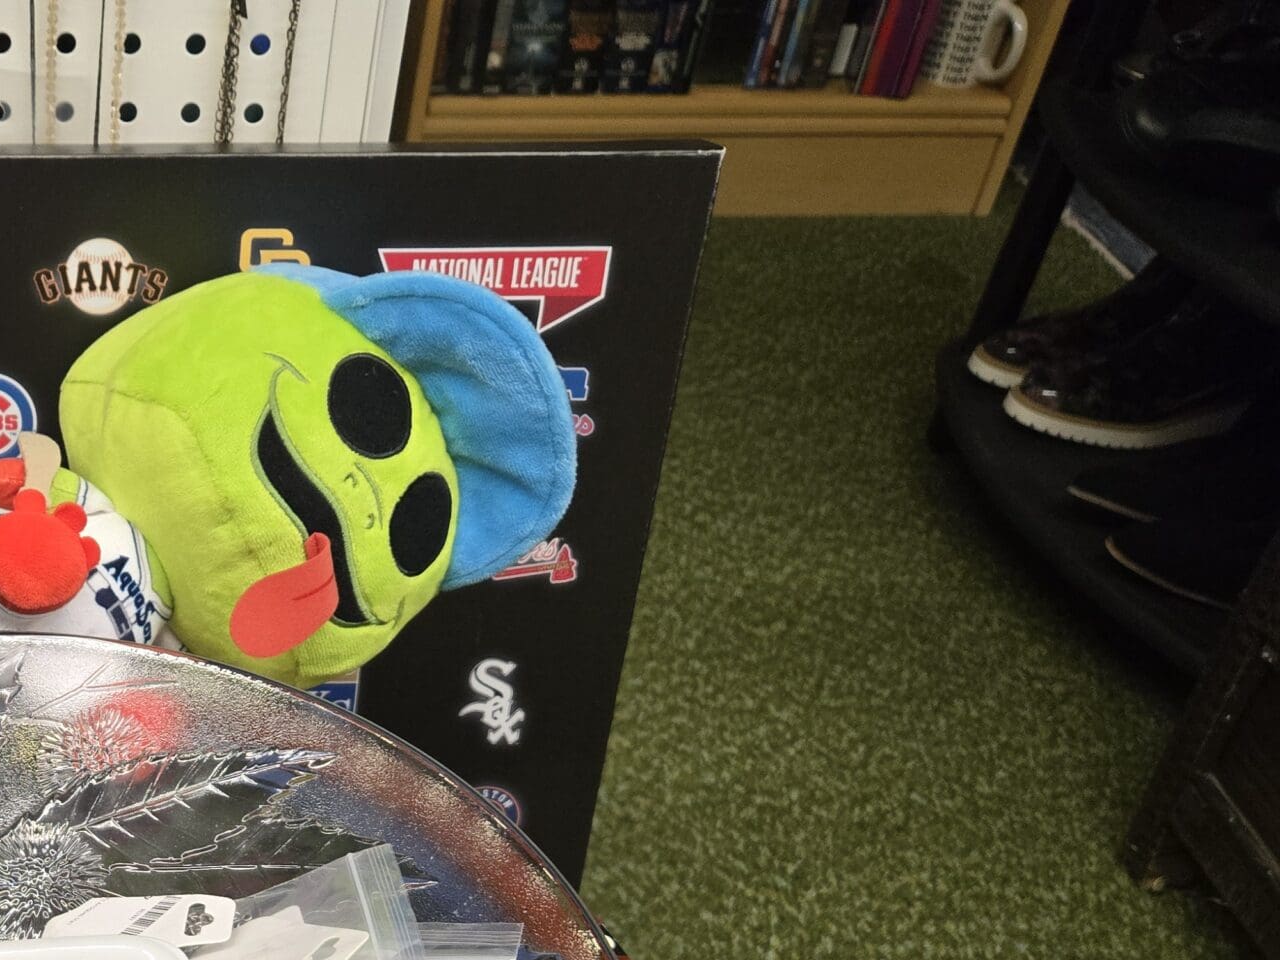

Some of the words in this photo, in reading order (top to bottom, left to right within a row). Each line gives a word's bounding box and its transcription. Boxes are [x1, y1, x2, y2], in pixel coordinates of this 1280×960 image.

[34, 261, 168, 304] GIANTS
[510, 257, 582, 288] LEAGUE
[458, 658, 526, 745] Sox
